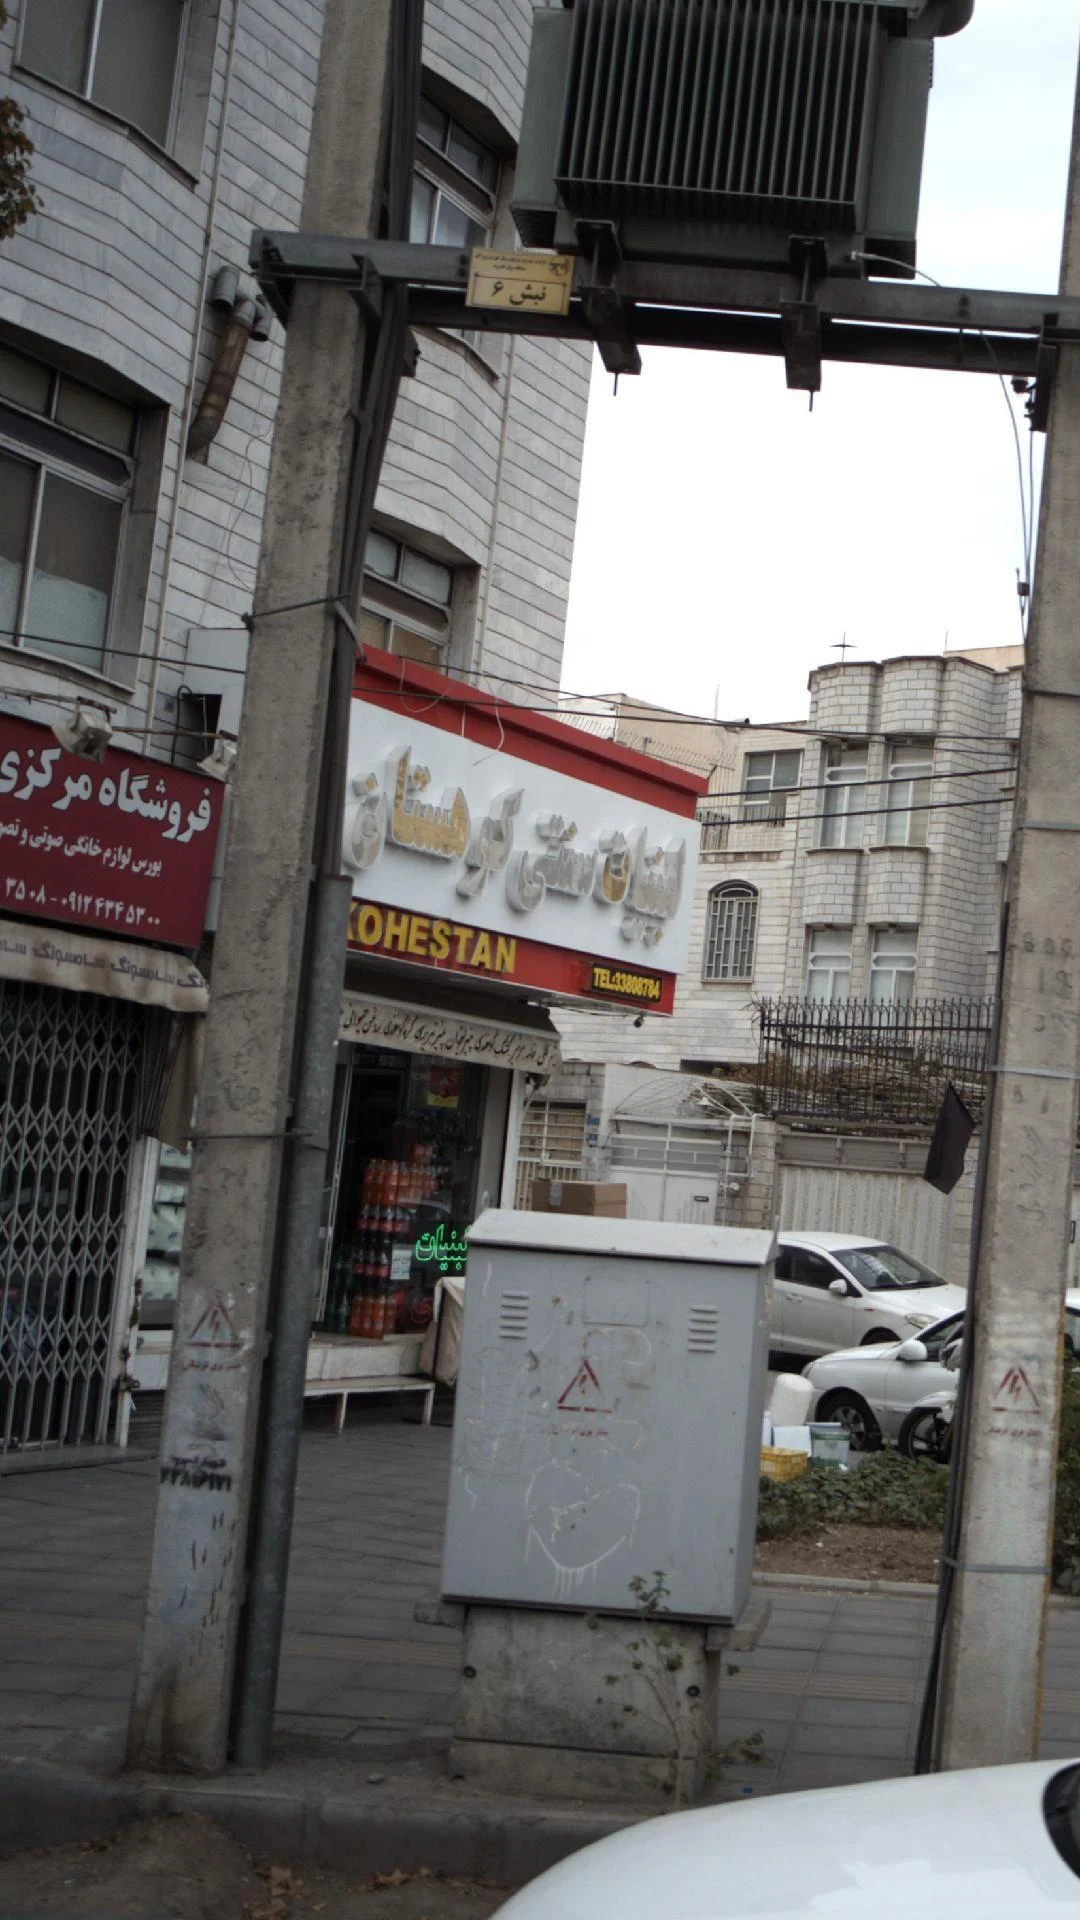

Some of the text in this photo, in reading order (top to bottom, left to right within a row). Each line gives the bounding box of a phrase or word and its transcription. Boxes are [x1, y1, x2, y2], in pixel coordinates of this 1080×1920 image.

[491, 280, 547, 306] نبش ۶
[0, 748, 212, 843] فروشگاه مرکزی
[20, 828, 28, 846] و
[28, 826, 63, 851] صوتی
[63, 835, 102, 857] خانگی
[342, 745, 687, 948] لبنیات سنتی کوهستان
[102, 845, 132, 870] لوازم
[131, 859, 163, 877] بورس
